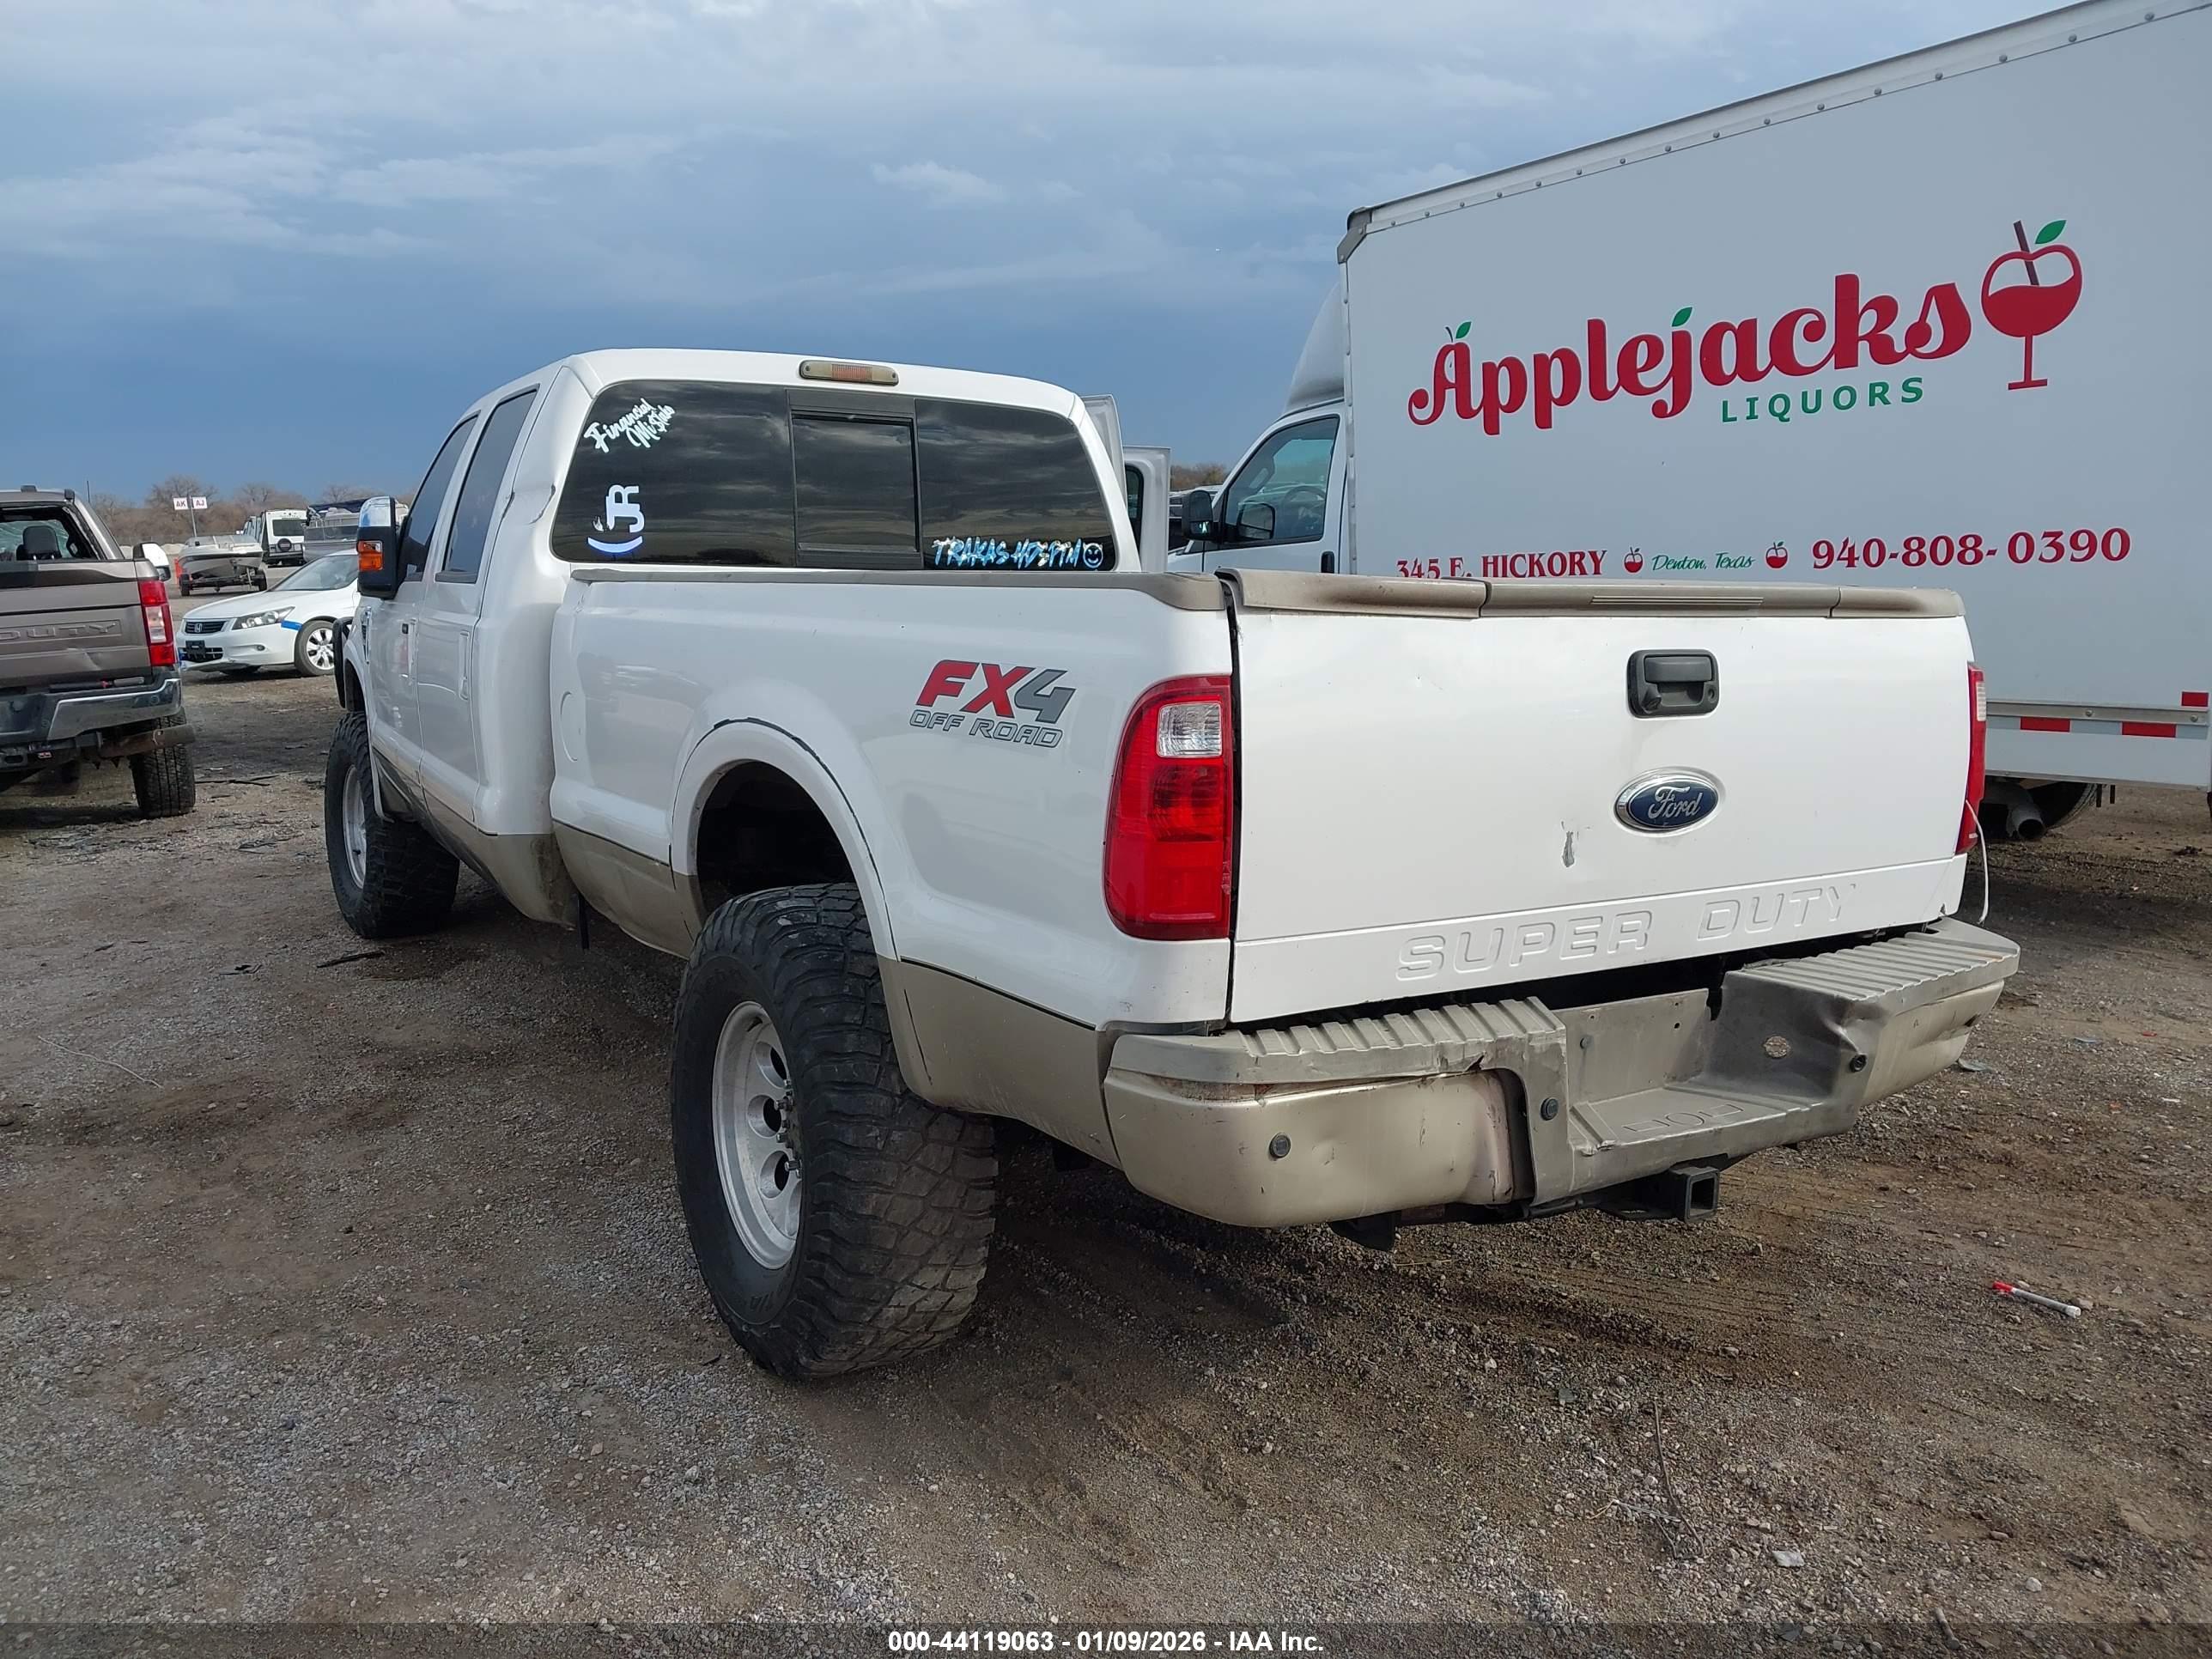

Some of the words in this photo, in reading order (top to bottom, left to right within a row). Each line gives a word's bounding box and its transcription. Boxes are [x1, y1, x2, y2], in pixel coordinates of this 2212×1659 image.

[1407, 273, 1972, 435] Applejacks
[1721, 376, 1923, 422] LIQUORS
[175, 498, 186, 507] AK
[195, 497, 205, 507] AJ
[1396, 556, 1441, 579] 345
[1481, 549, 1607, 578] HICKORY
[1715, 551, 1756, 569] Texas
[915, 659, 1078, 725] FX4
[908, 708, 966, 732] OFF
[968, 717, 1064, 749] ROAD
[1648, 786, 1704, 819] Ford
[1395, 908, 1654, 982] SUPER
[1696, 882, 1857, 942] DUTY
